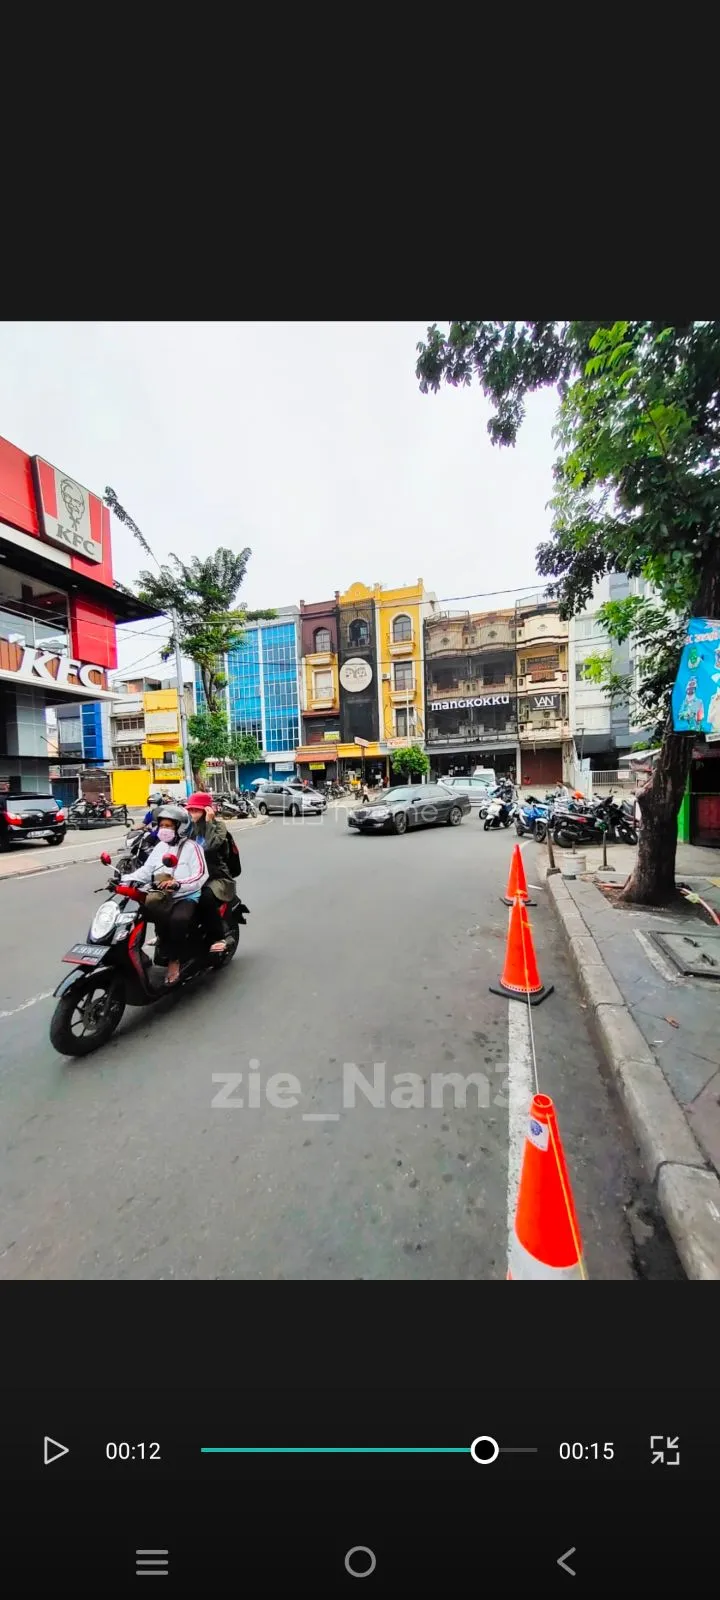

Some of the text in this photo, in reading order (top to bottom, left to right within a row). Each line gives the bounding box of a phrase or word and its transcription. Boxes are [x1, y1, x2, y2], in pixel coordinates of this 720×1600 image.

[56, 523, 96, 556] KFC
[20, 649, 106, 689] KFC
[533, 695, 554, 707] VAN
